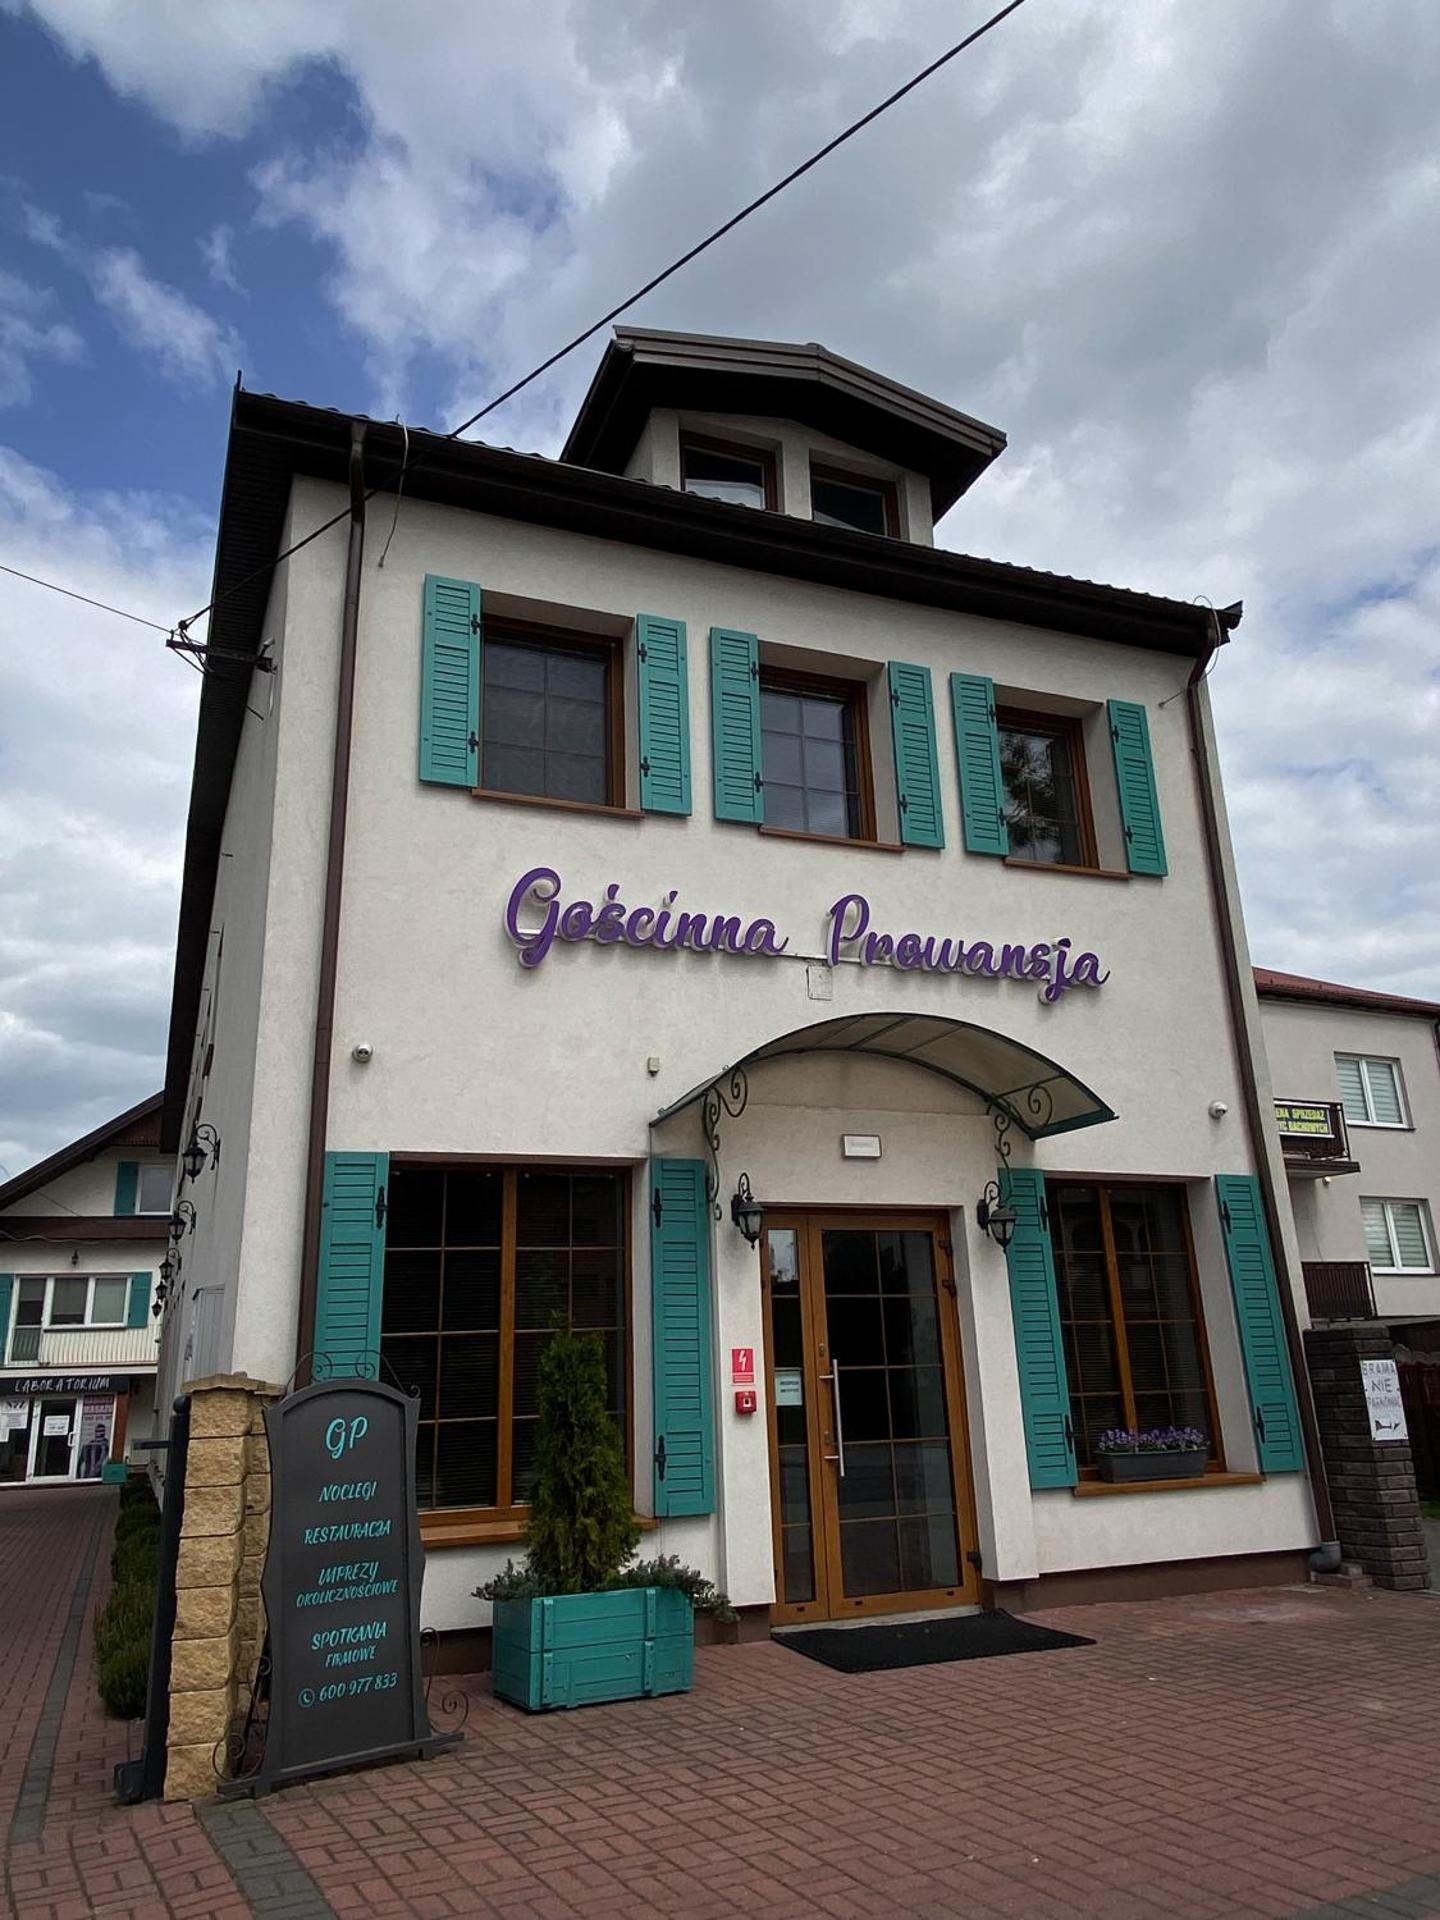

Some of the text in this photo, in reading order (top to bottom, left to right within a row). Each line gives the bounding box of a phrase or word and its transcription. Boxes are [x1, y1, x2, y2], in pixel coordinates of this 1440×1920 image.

[507, 867, 1110, 1003] Gościnna Prowansja
[15, 1377, 110, 1392] LABORATORIUM
[1371, 1378, 1393, 1393] NIE
[325, 1416, 368, 1459] GP
[319, 1481, 377, 1502] NOCLEGI
[304, 1519, 391, 1545] RESTAURACJA
[318, 1561, 379, 1586] IMPREZY
[296, 1579, 398, 1608] OKOLICZNOŚCIOWE
[311, 1621, 387, 1650] SPOTKANIA
[325, 1645, 376, 1668] FIRMOWE
[319, 1672, 398, 1701] 600 977 833
